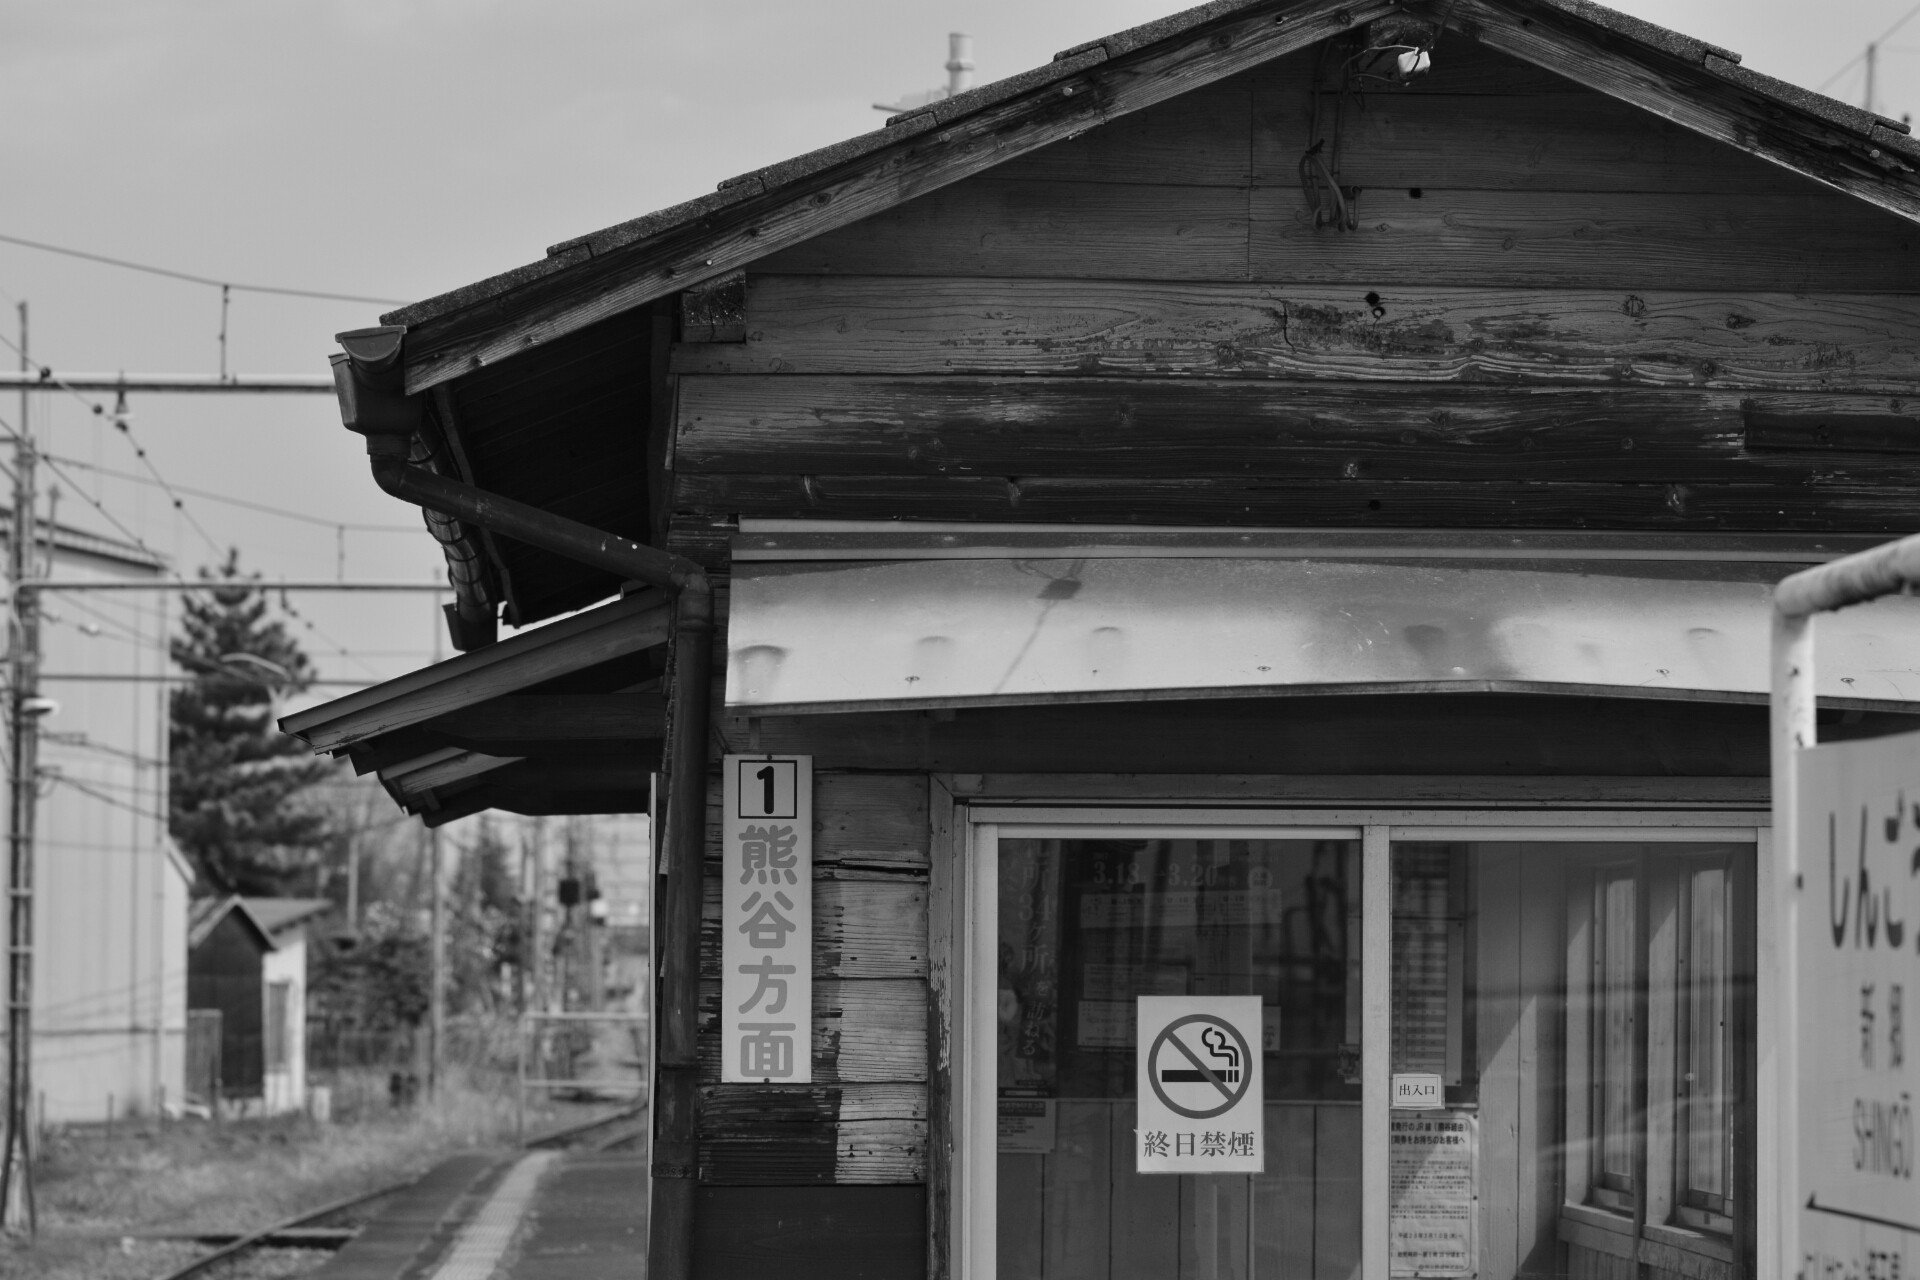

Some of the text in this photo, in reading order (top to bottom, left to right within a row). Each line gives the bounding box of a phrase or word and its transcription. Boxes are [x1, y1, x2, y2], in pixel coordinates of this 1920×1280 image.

[756, 765, 774, 815] 1
[738, 824, 798, 1078] 熊谷方面
[1399, 1083, 1435, 1096] 出入口
[1143, 1130, 1255, 1158] 終日禁煙
